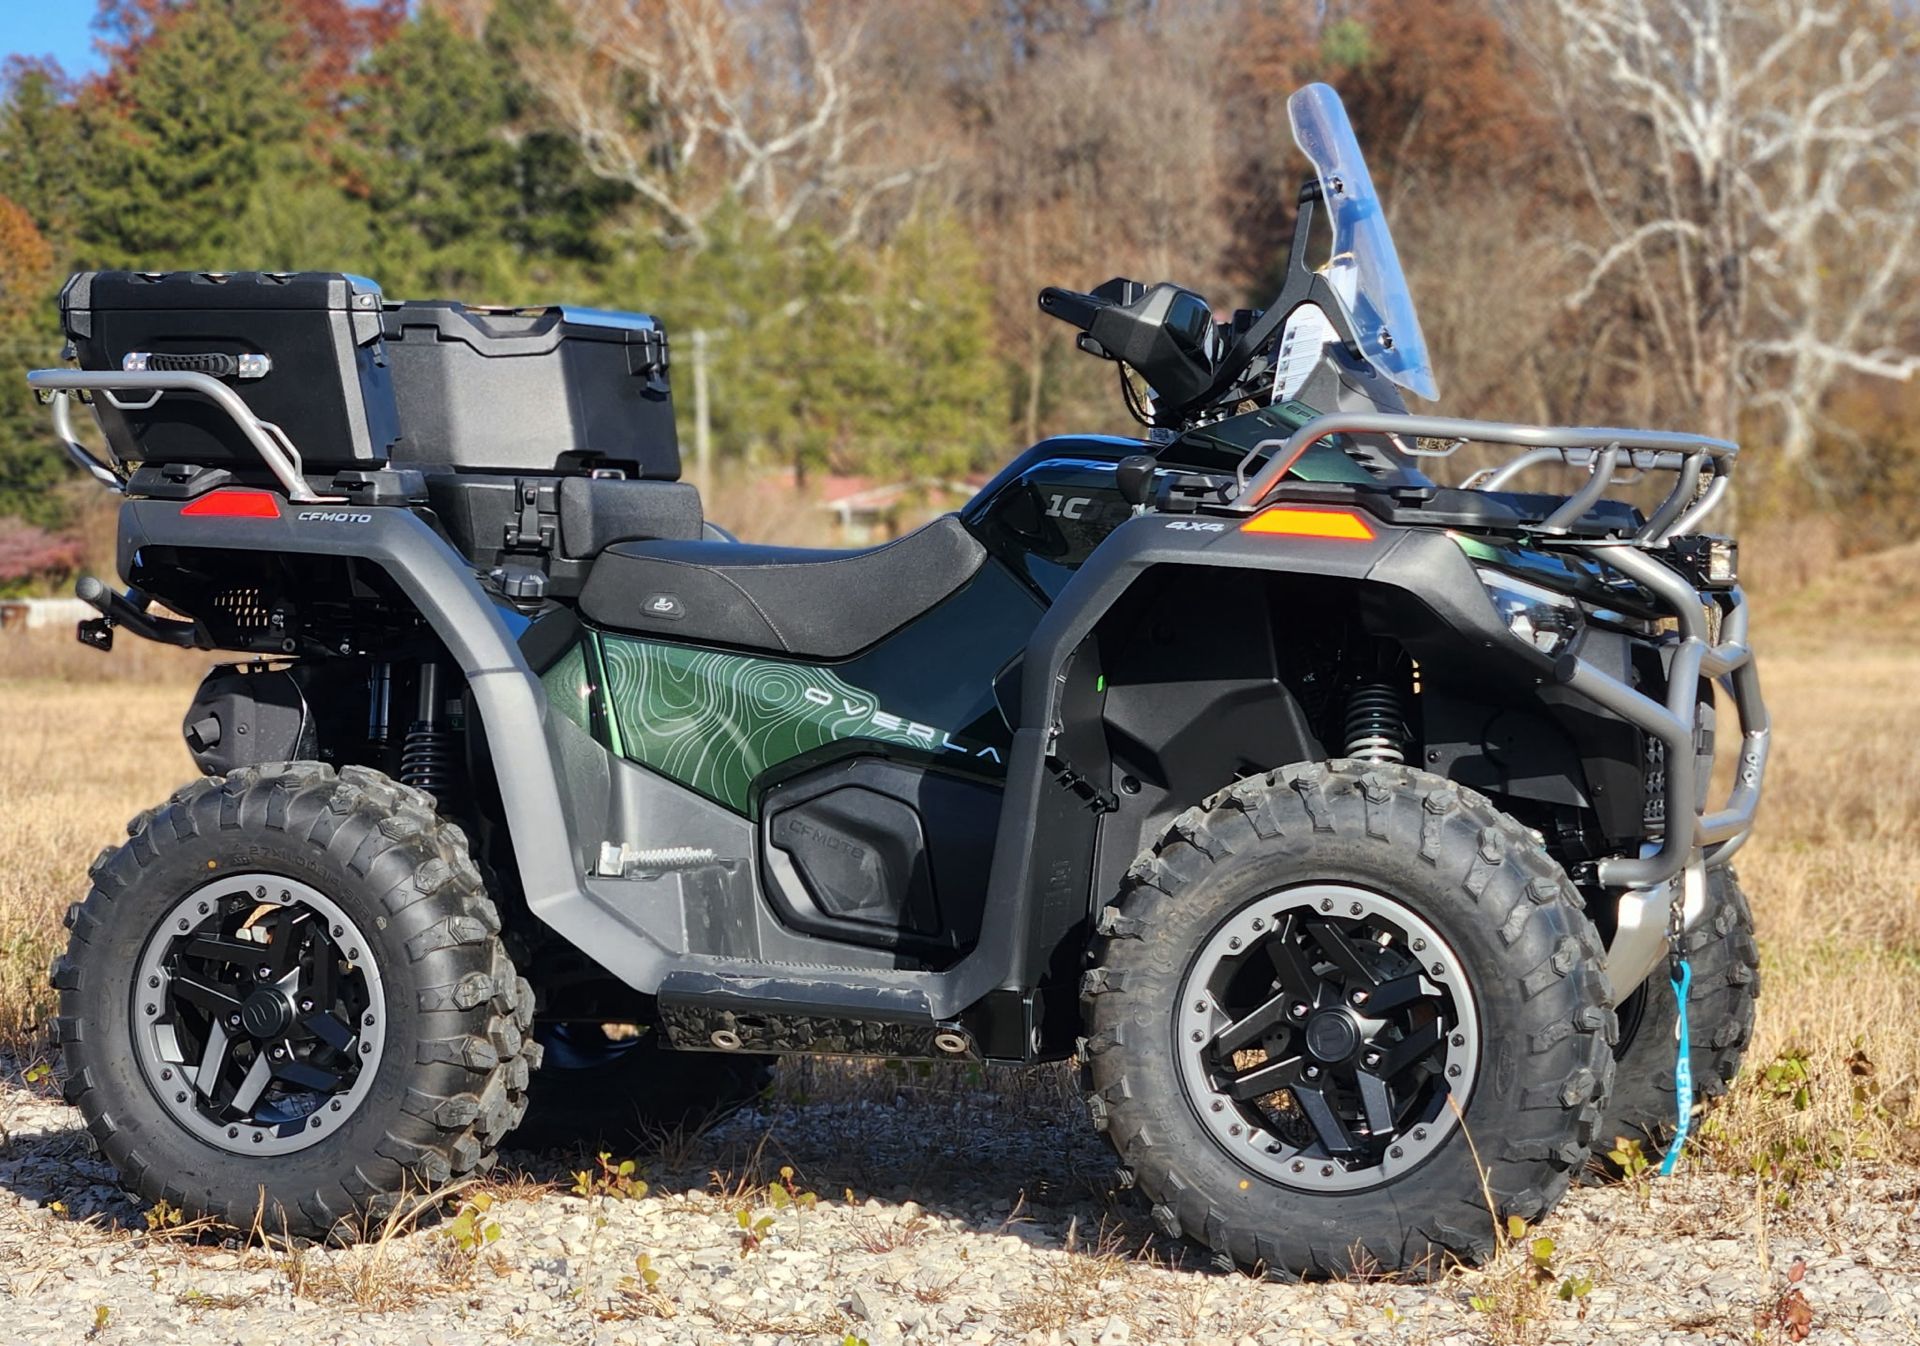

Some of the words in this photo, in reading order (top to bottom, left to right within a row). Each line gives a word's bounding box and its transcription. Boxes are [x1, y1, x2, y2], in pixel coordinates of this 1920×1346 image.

[298, 512, 372, 523] CFMOTO
[789, 819, 865, 859] CFMOTO
[1671, 1057, 1692, 1153] CFMOTO
